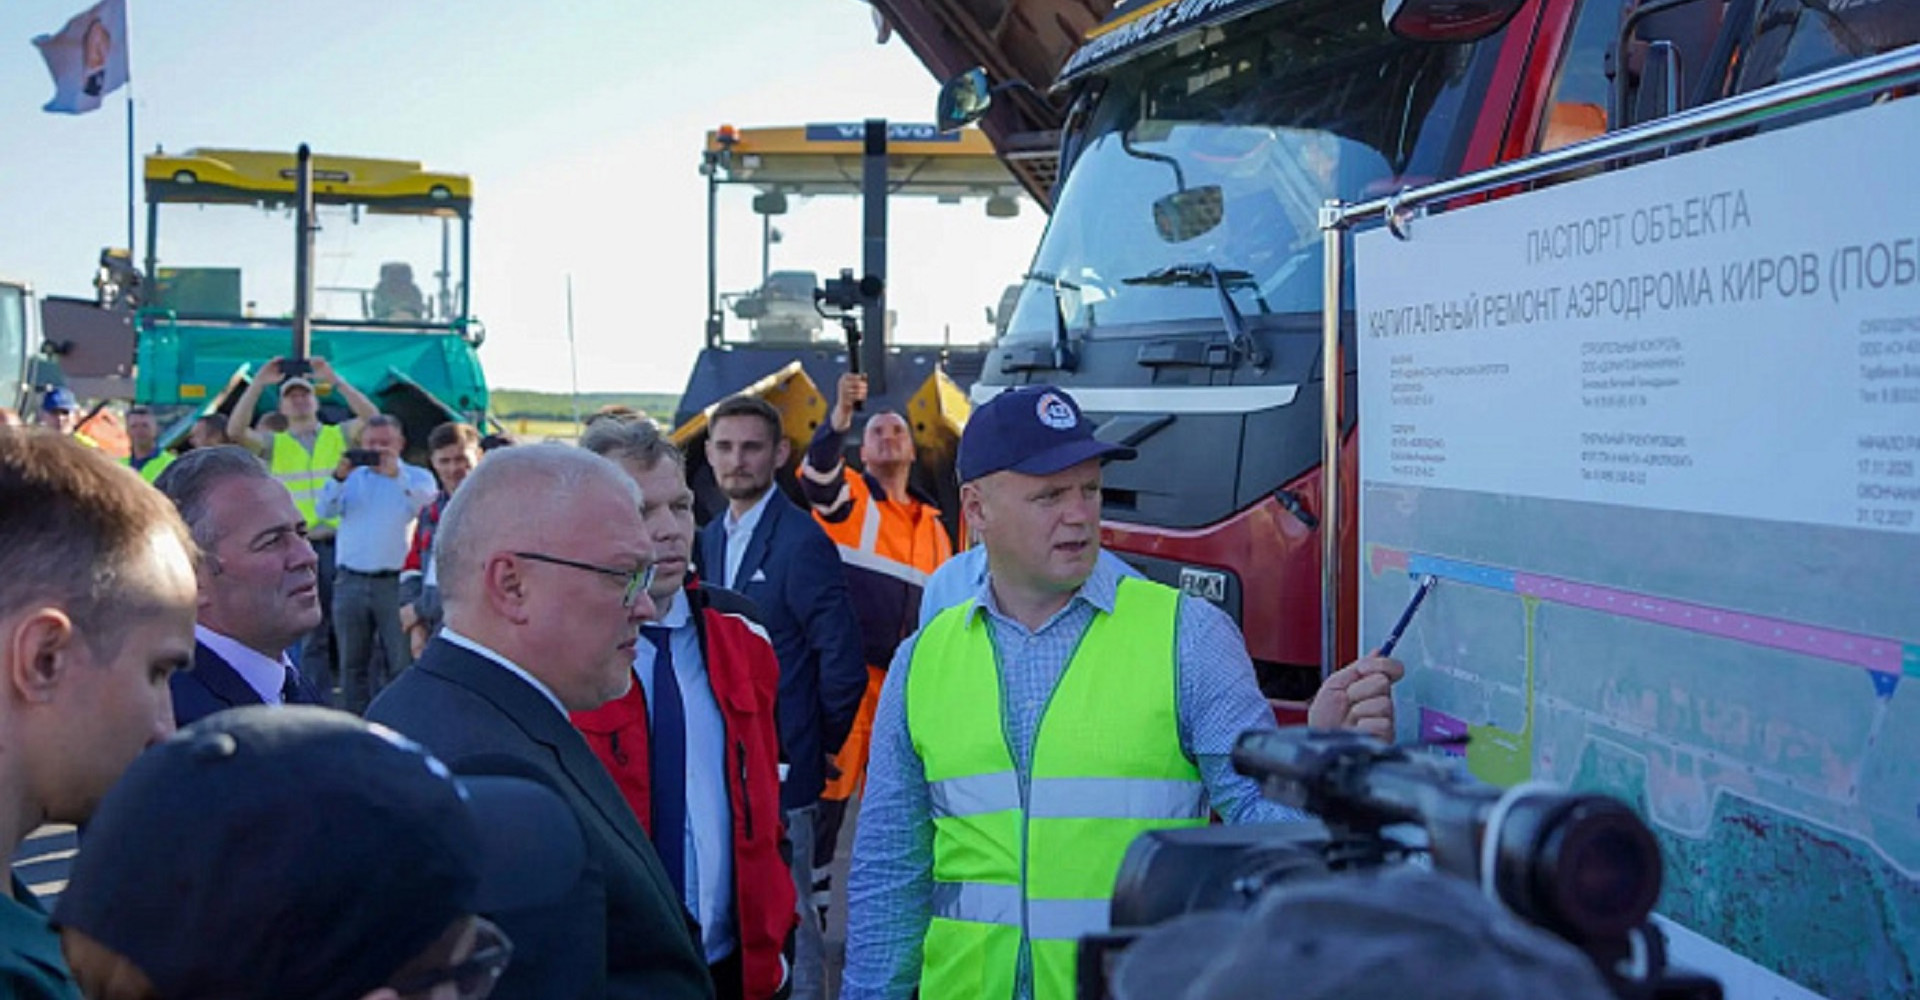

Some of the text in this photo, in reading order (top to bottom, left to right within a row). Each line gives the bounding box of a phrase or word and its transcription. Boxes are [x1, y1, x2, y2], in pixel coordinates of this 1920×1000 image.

[837, 126, 934, 138] VVO
[1526, 189, 1751, 265] ПАСПОРТ ОБЪЕКТА
[1369, 234, 1920, 338] КАПИТАЛЬНЫЙ РЕМОНТ АЭРОДРОМА КИРОВ (ПОБ
